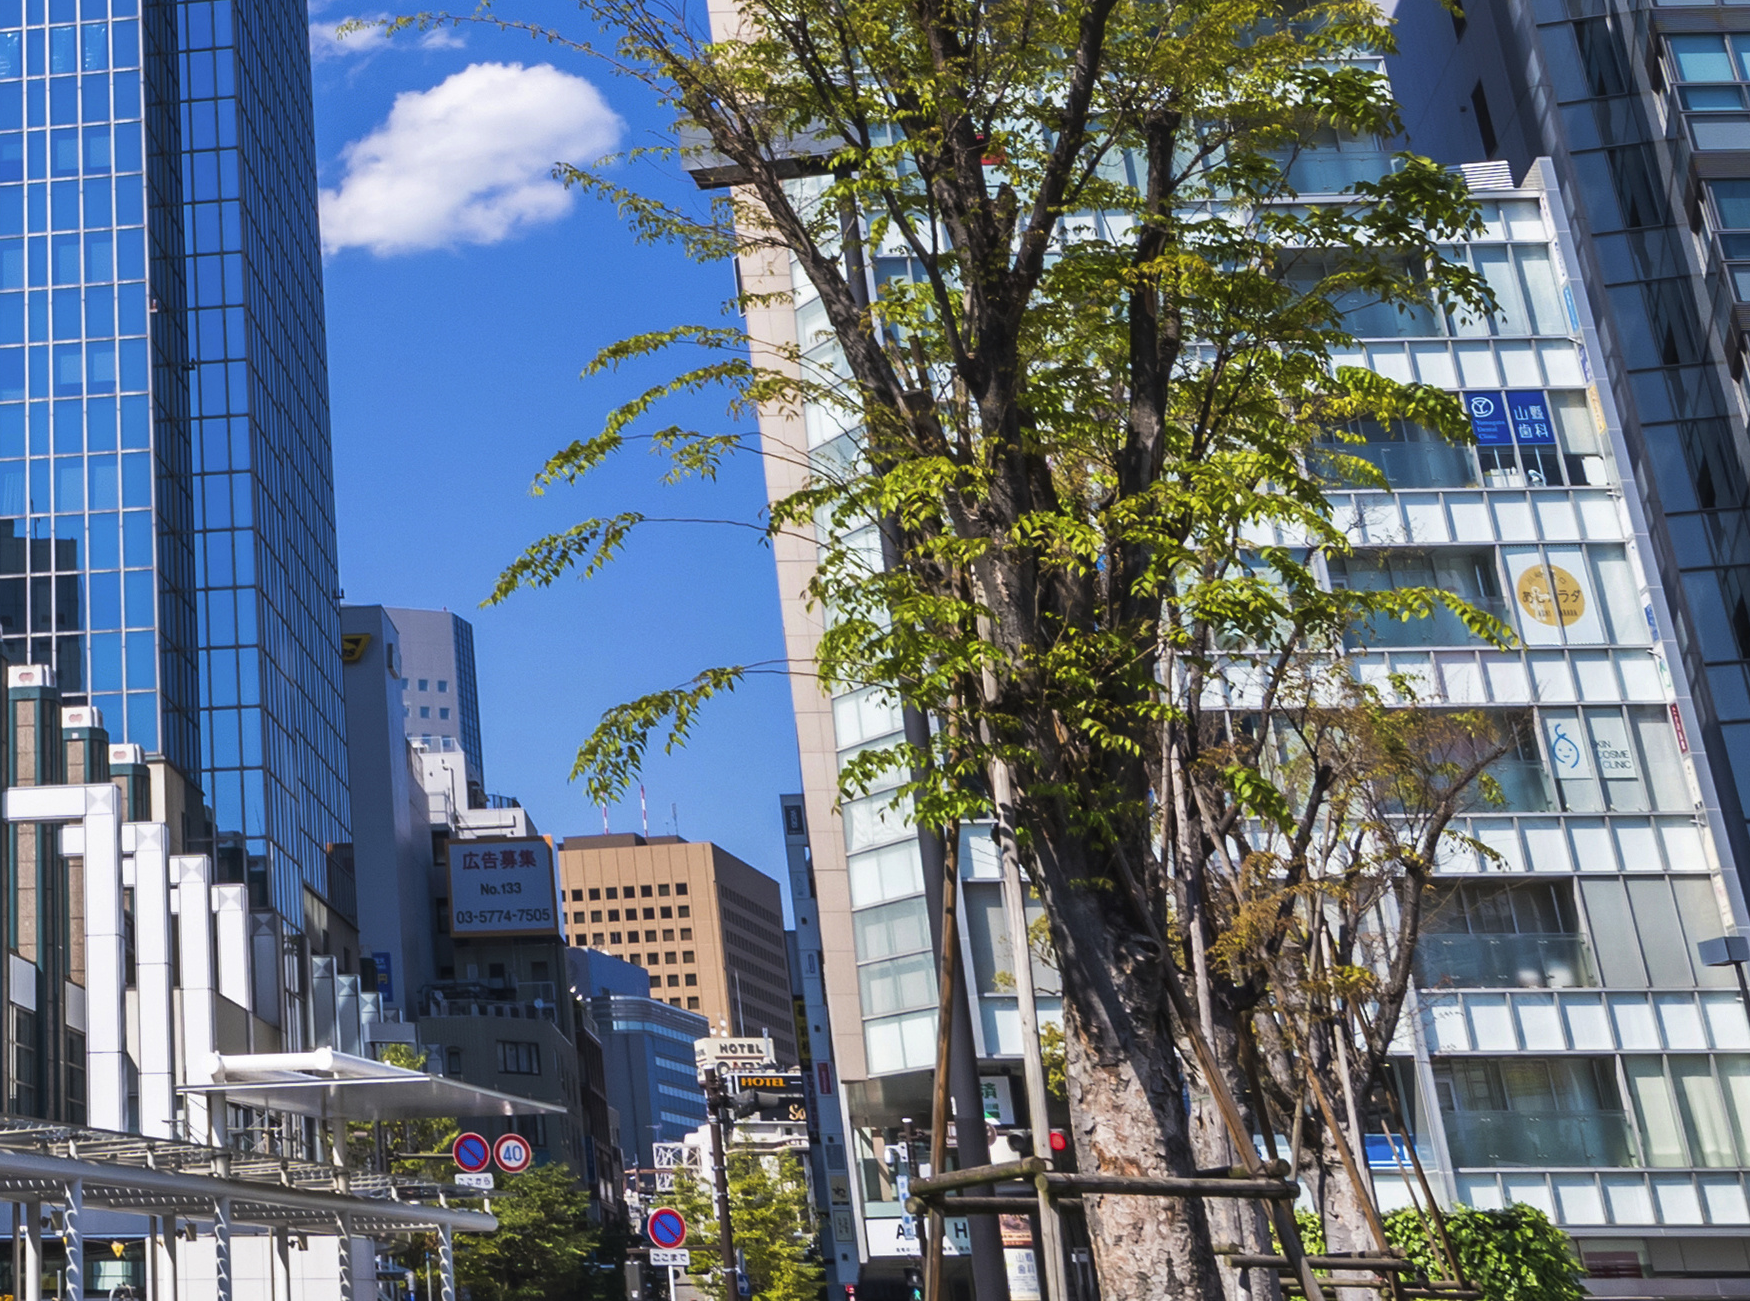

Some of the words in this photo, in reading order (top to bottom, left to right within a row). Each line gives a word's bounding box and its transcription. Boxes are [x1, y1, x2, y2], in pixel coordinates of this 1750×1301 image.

[462, 849, 537, 870] 広告募集
[480, 882, 522, 896] No.133
[456, 908, 551, 925] 03-5774-7505
[718, 1042, 764, 1055] HOTEL
[741, 1076, 787, 1088] HOTEL
[503, 1144, 523, 1162] 40
[652, 1252, 688, 1263] ここまで
